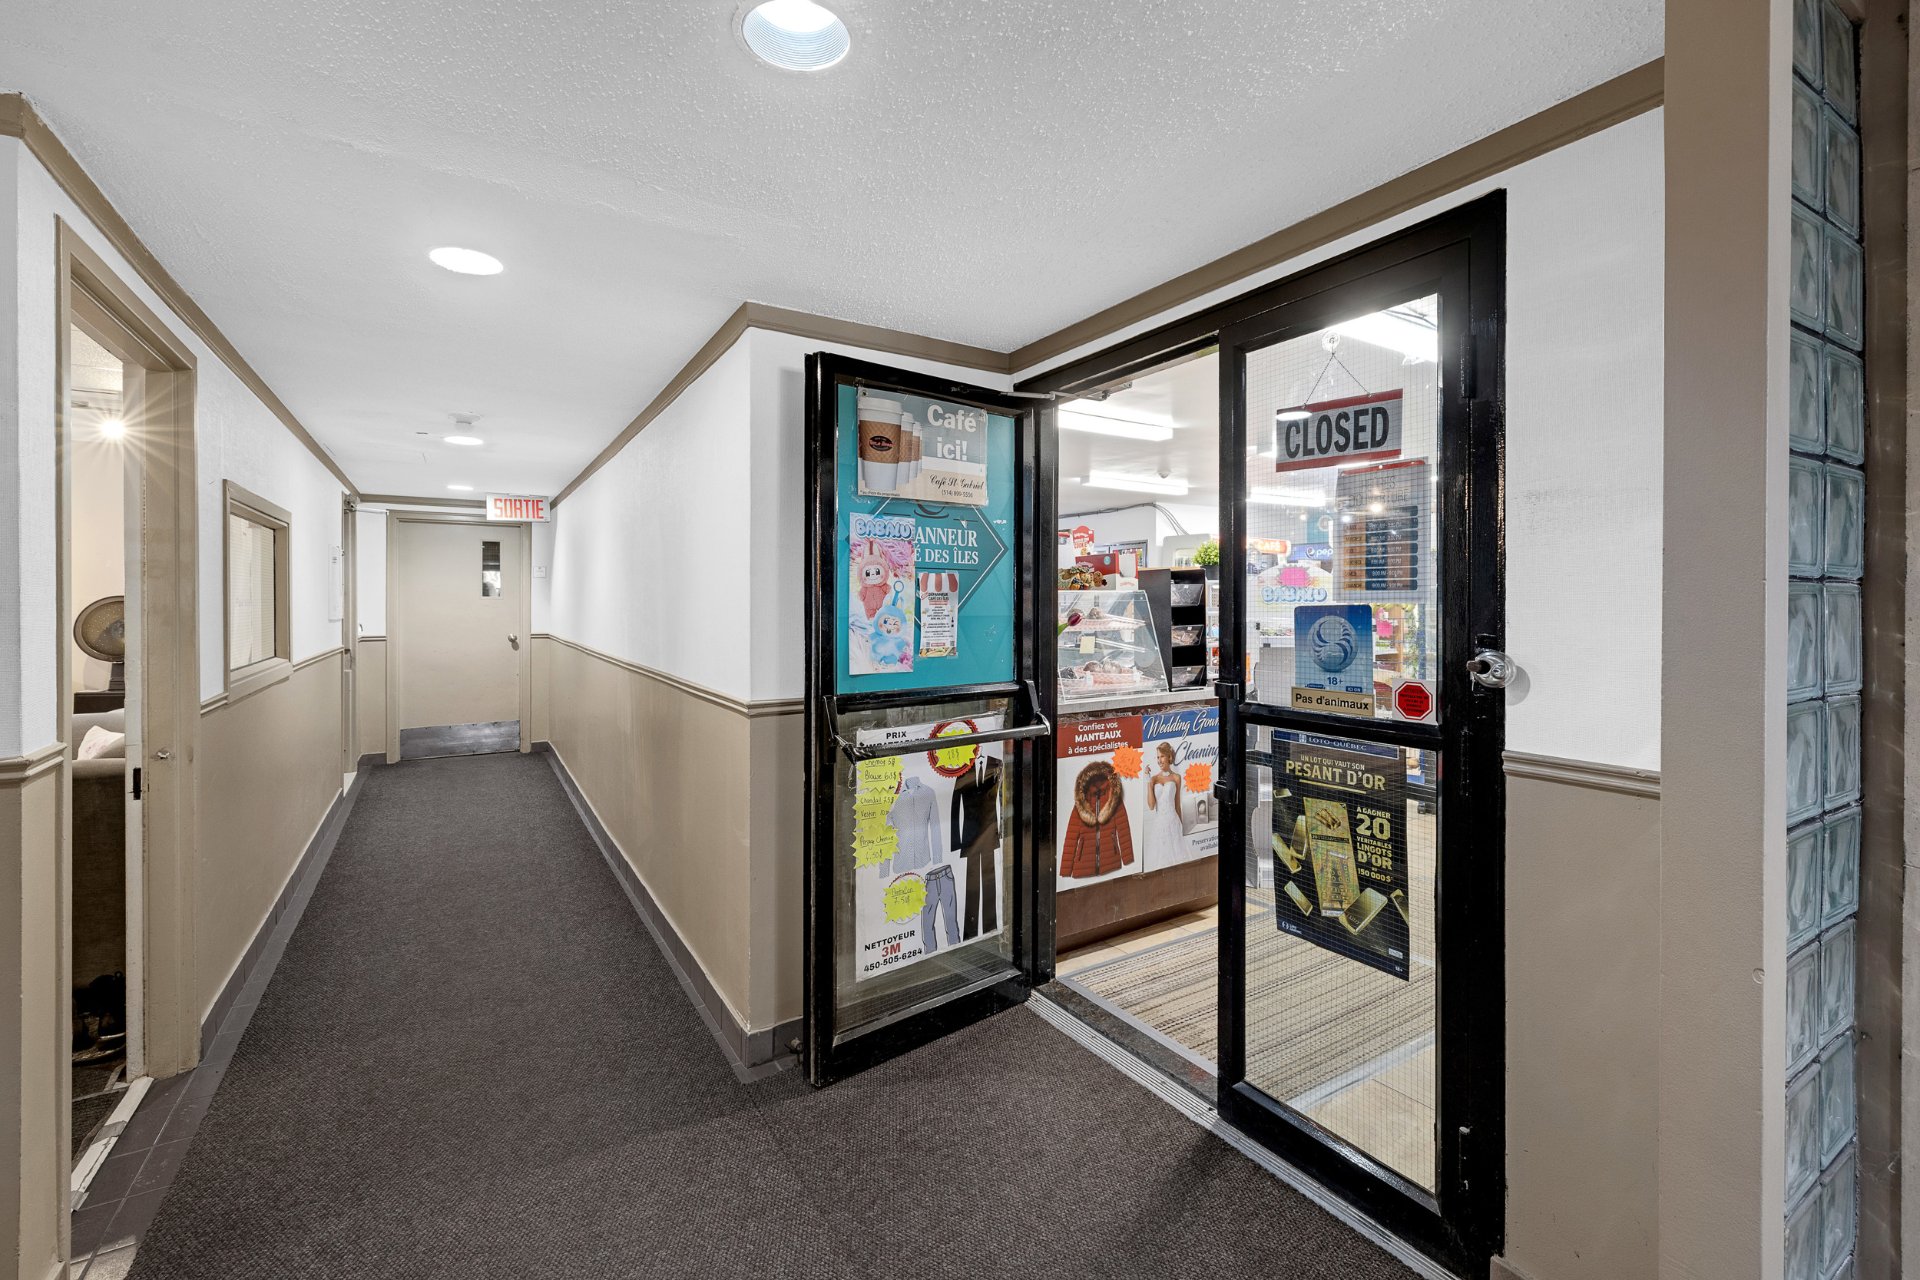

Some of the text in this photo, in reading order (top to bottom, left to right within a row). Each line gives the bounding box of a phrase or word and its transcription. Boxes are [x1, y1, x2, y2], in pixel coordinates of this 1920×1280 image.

[927, 404, 976, 432] Café
[1286, 406, 1390, 458] CLOSED
[936, 436, 968, 461] ici!
[493, 498, 544, 519] SORTIE
[855, 518, 913, 538] BABALU
[925, 548, 950, 564] DES
[954, 546, 979, 564] ÎLES
[1328, 676, 1344, 686] 18+
[1296, 694, 1369, 710] Pas d'animaux
[886, 730, 907, 740] PRIX
[1075, 730, 1122, 742] MANTEAUX
[1078, 723, 1104, 732] Confiez
[1144, 717, 1190, 740] Wedding
[1074, 745, 1088, 754] des
[1088, 741, 1128, 752] spécialistes
[1308, 736, 1367, 750] LOTO-QUÉBEC
[1174, 740, 1219, 766] Cleaning
[1301, 754, 1309, 762] UN
[1310, 756, 1321, 764] LOT
[1335, 760, 1351, 768] VAUT
[1352, 763, 1365, 771] SON
[1286, 760, 1386, 791] PESANT D'OR
[1362, 807, 1391, 819] GAGNER
[1356, 813, 1391, 840] 20
[1357, 842, 1392, 858] LINGOTS
[1358, 850, 1392, 870] D'OR
[1358, 868, 1370, 877] 150
[864, 930, 915, 952] NETTOYEUR
[882, 943, 901, 957] 3M
